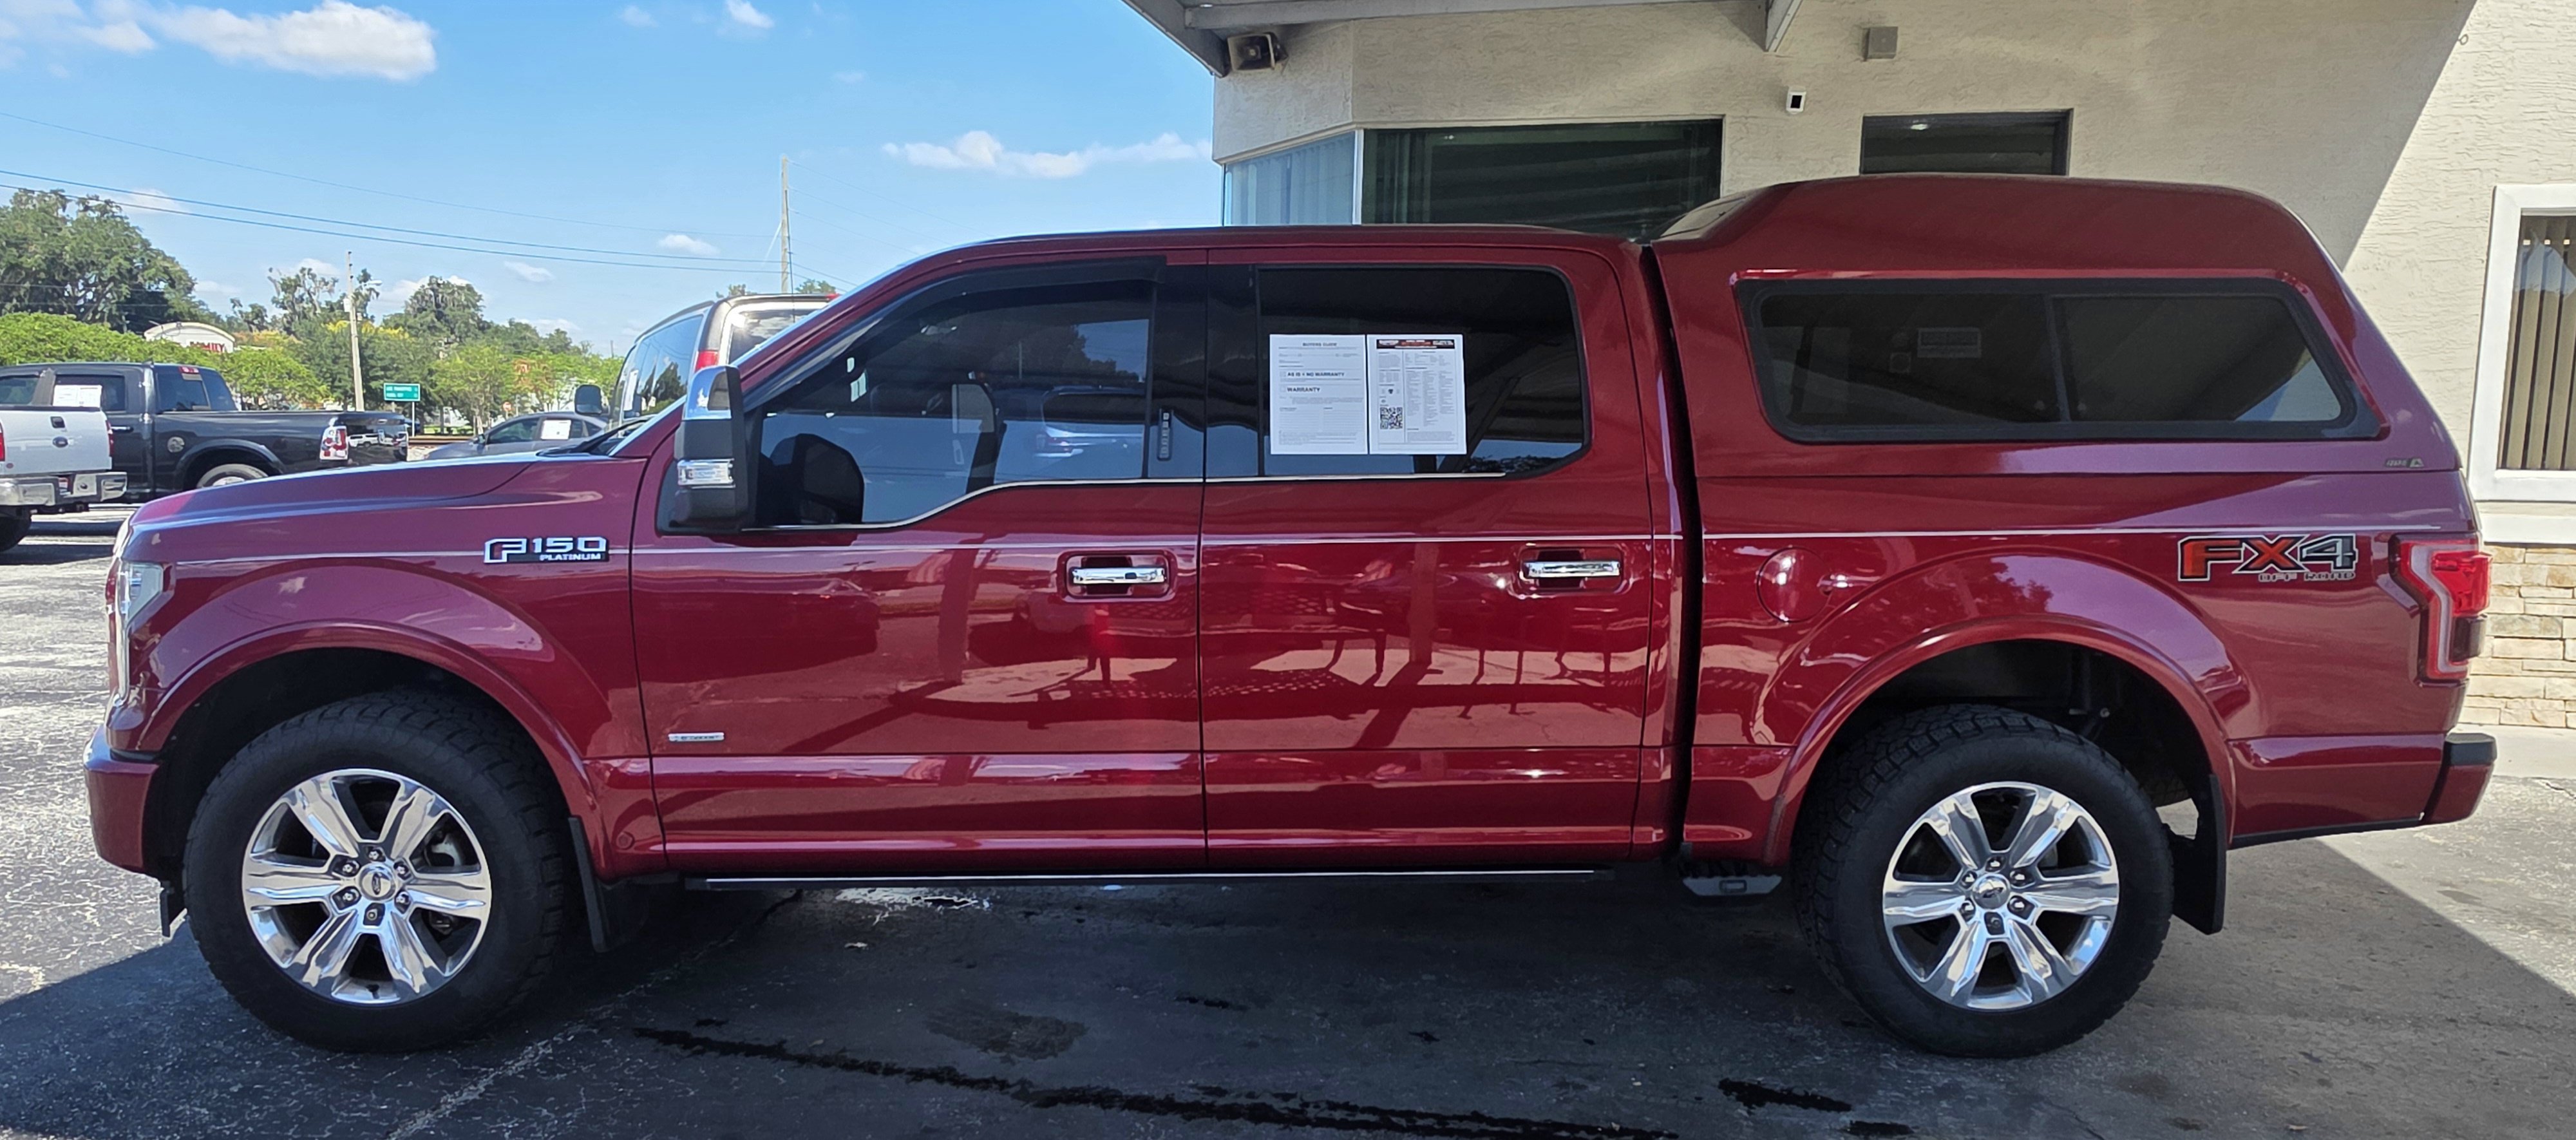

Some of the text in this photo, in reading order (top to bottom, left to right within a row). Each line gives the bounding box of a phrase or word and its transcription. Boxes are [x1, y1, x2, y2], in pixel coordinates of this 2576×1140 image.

[539, 553, 601, 562] PLATINUM
[2177, 533, 2358, 582] FX4
[2258, 571, 2356, 582] OFF ROAD
